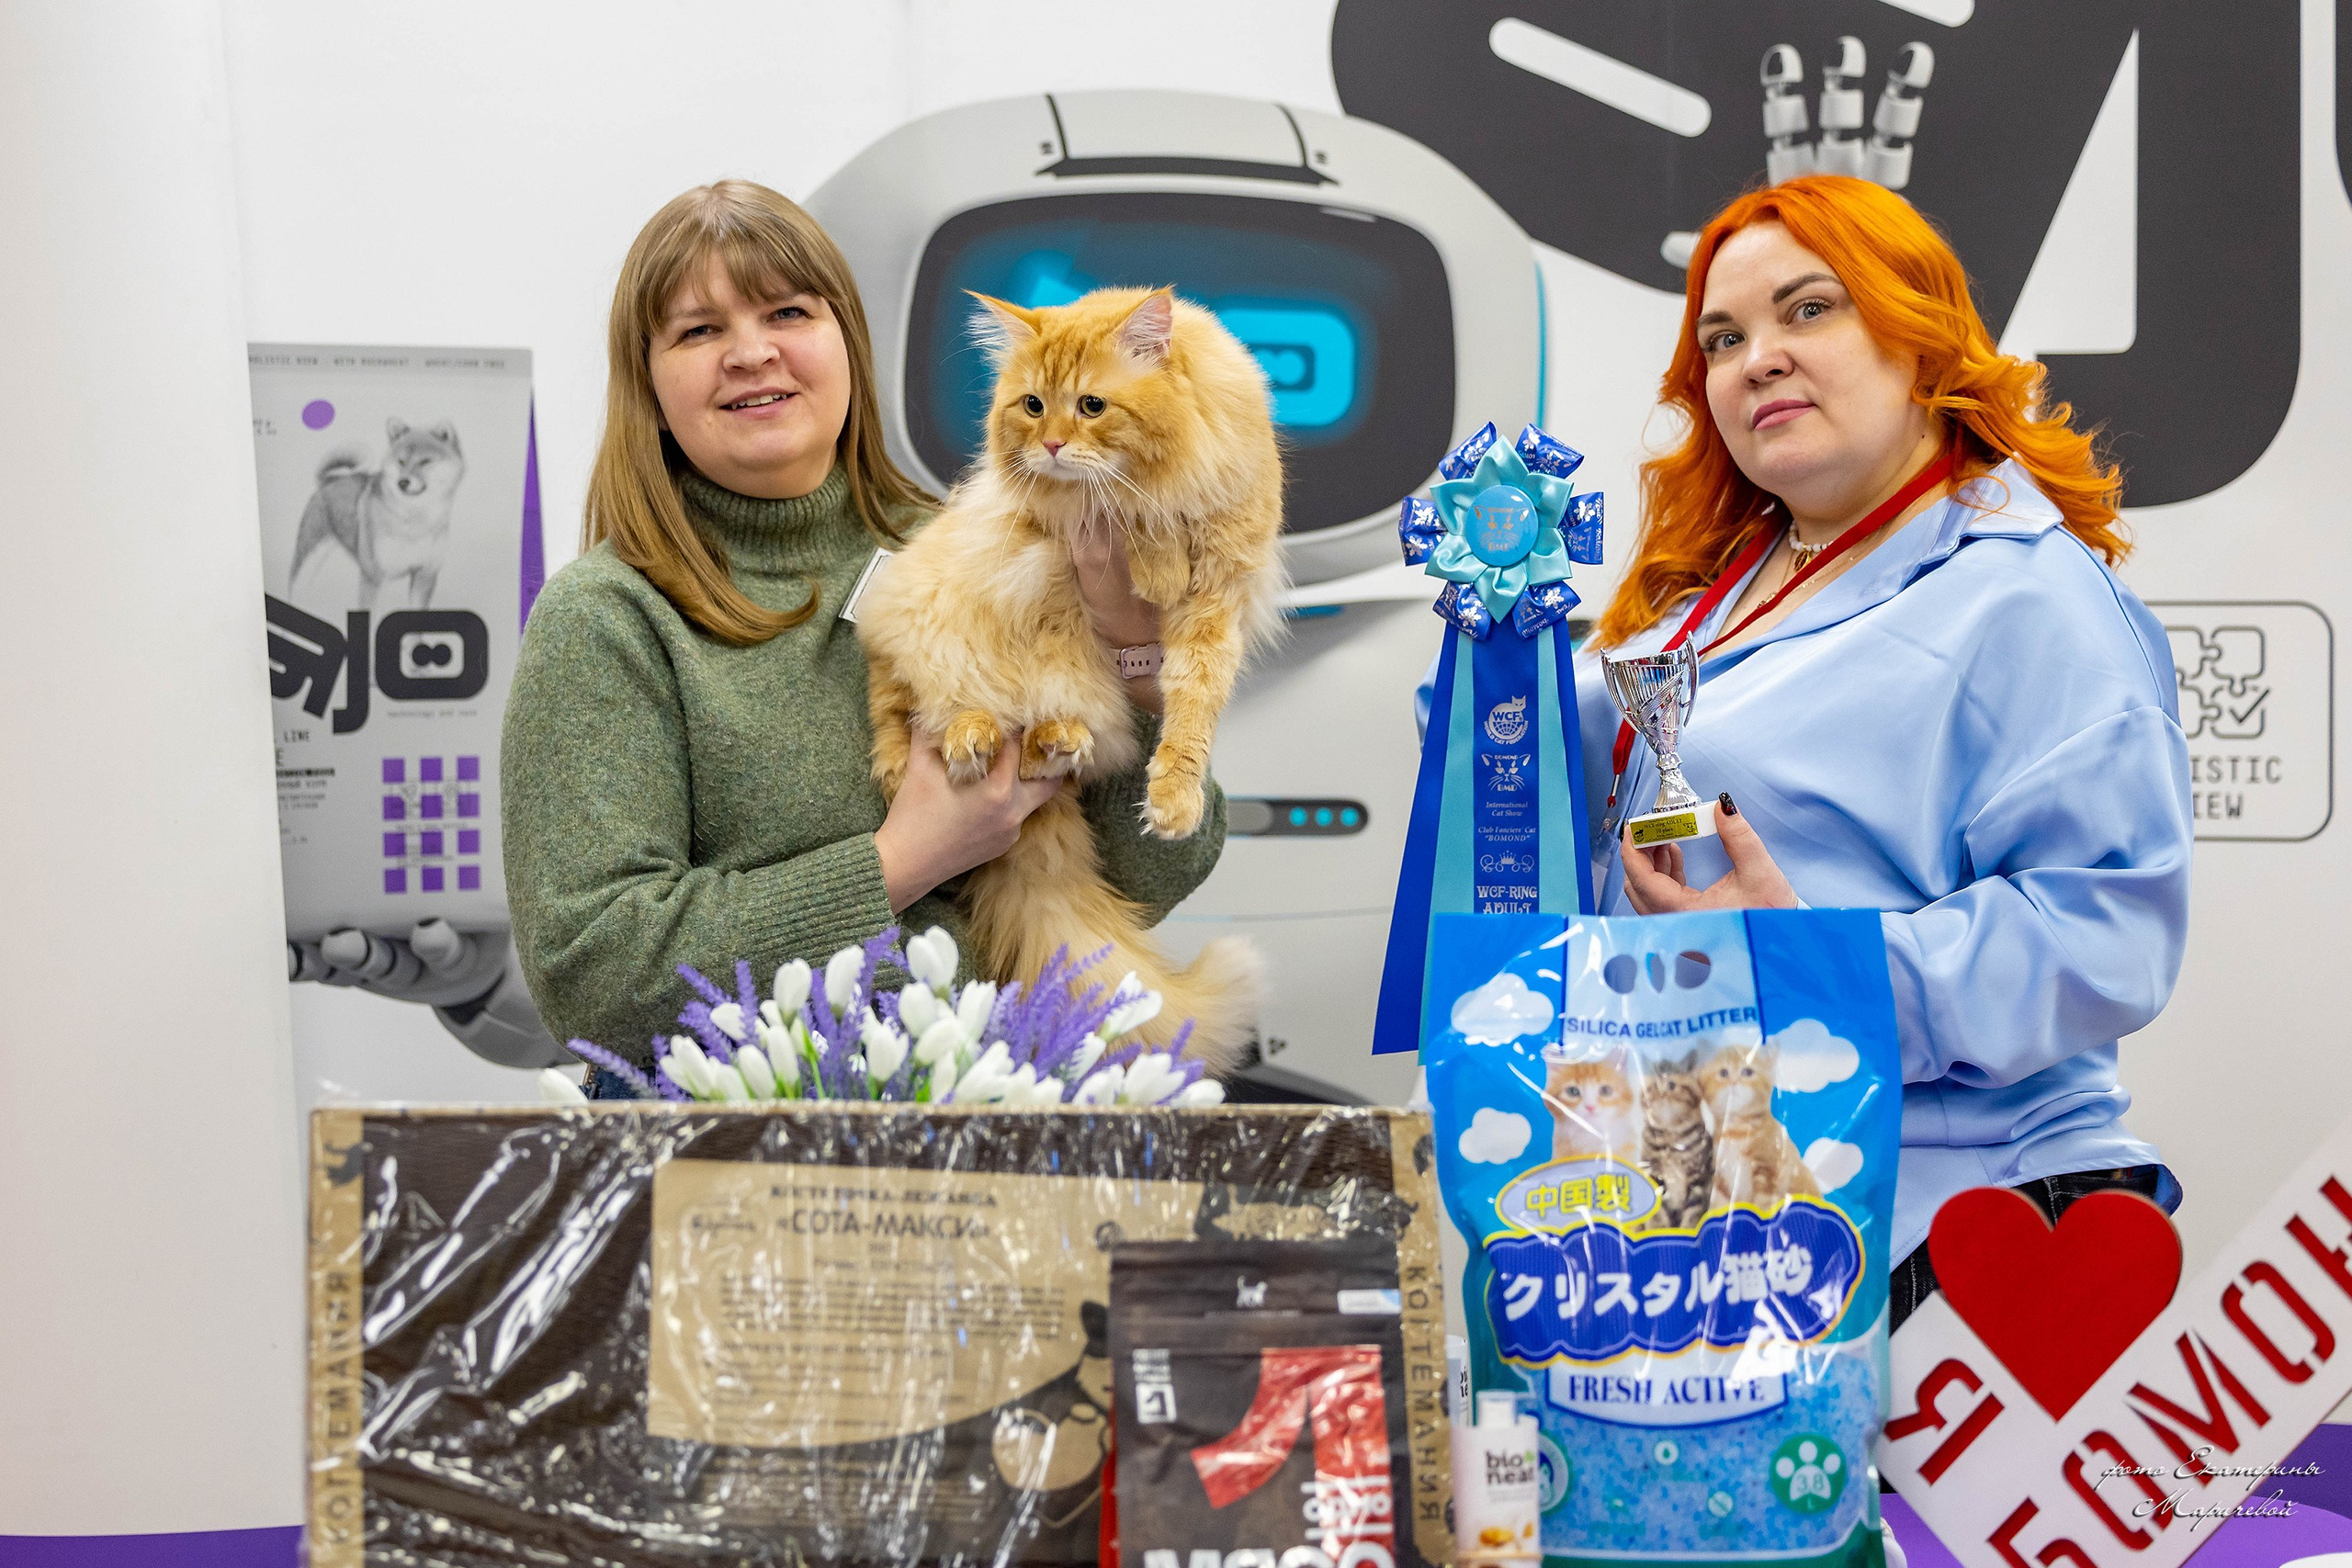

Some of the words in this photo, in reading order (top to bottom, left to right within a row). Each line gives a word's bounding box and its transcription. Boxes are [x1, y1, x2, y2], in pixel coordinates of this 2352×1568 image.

[1492, 711, 1521, 722] WCF
[2189, 755, 2283, 784] ISTIC
[2193, 793, 2244, 819] IEW
[1476, 886, 1538, 899] WCF-RING
[1566, 1018, 1631, 1038] SILICA
[1686, 1006, 1758, 1033] LITTER
[1503, 1244, 1814, 1322] クリスタル猫砂
[1568, 1375, 1652, 1404] FRESH
[1883, 1358, 2005, 1486] Я
